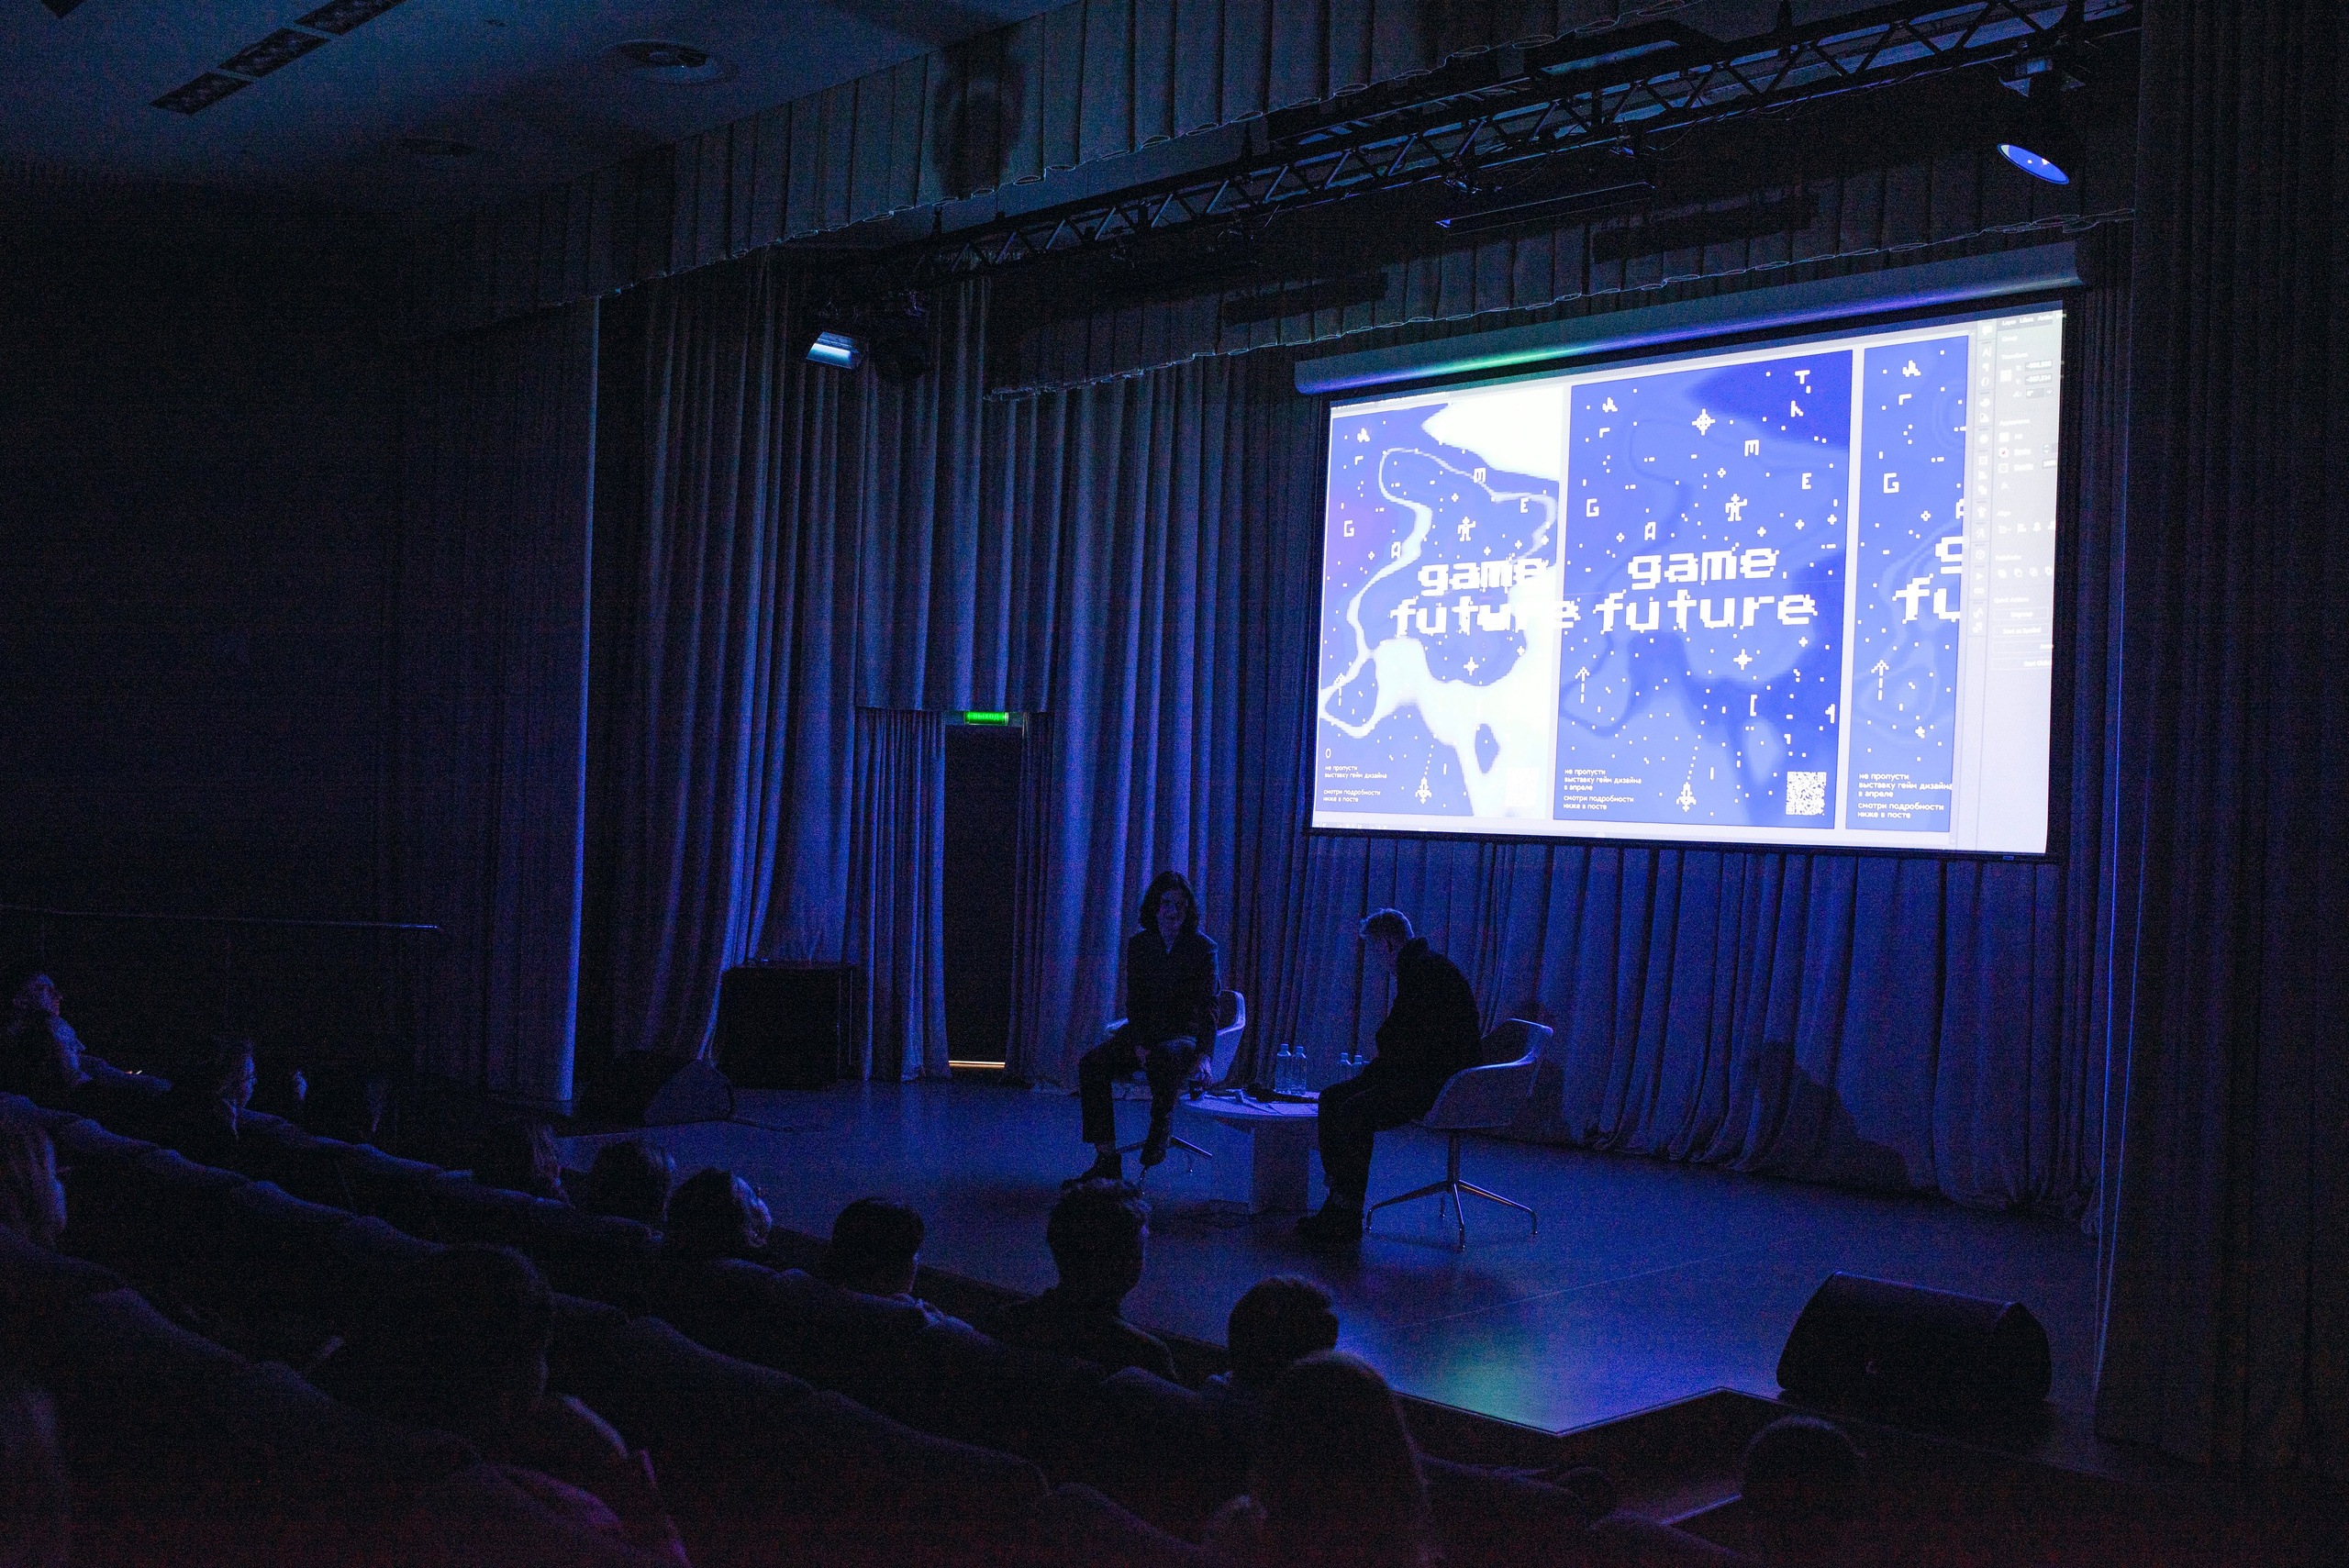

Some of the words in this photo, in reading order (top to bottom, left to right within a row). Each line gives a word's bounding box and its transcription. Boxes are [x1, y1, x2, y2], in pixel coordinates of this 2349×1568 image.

[1628, 548, 1777, 590] game
[1418, 558, 1549, 596] game
[1593, 589, 1817, 634] future
[973, 713, 999, 721] ВЫХОД
[1614, 776, 1642, 784] дизайна
[1871, 773, 1909, 782] пропусти
[1859, 782, 1896, 790] выставку
[1589, 795, 1634, 803] подробности
[1888, 802, 1944, 811] подробности
